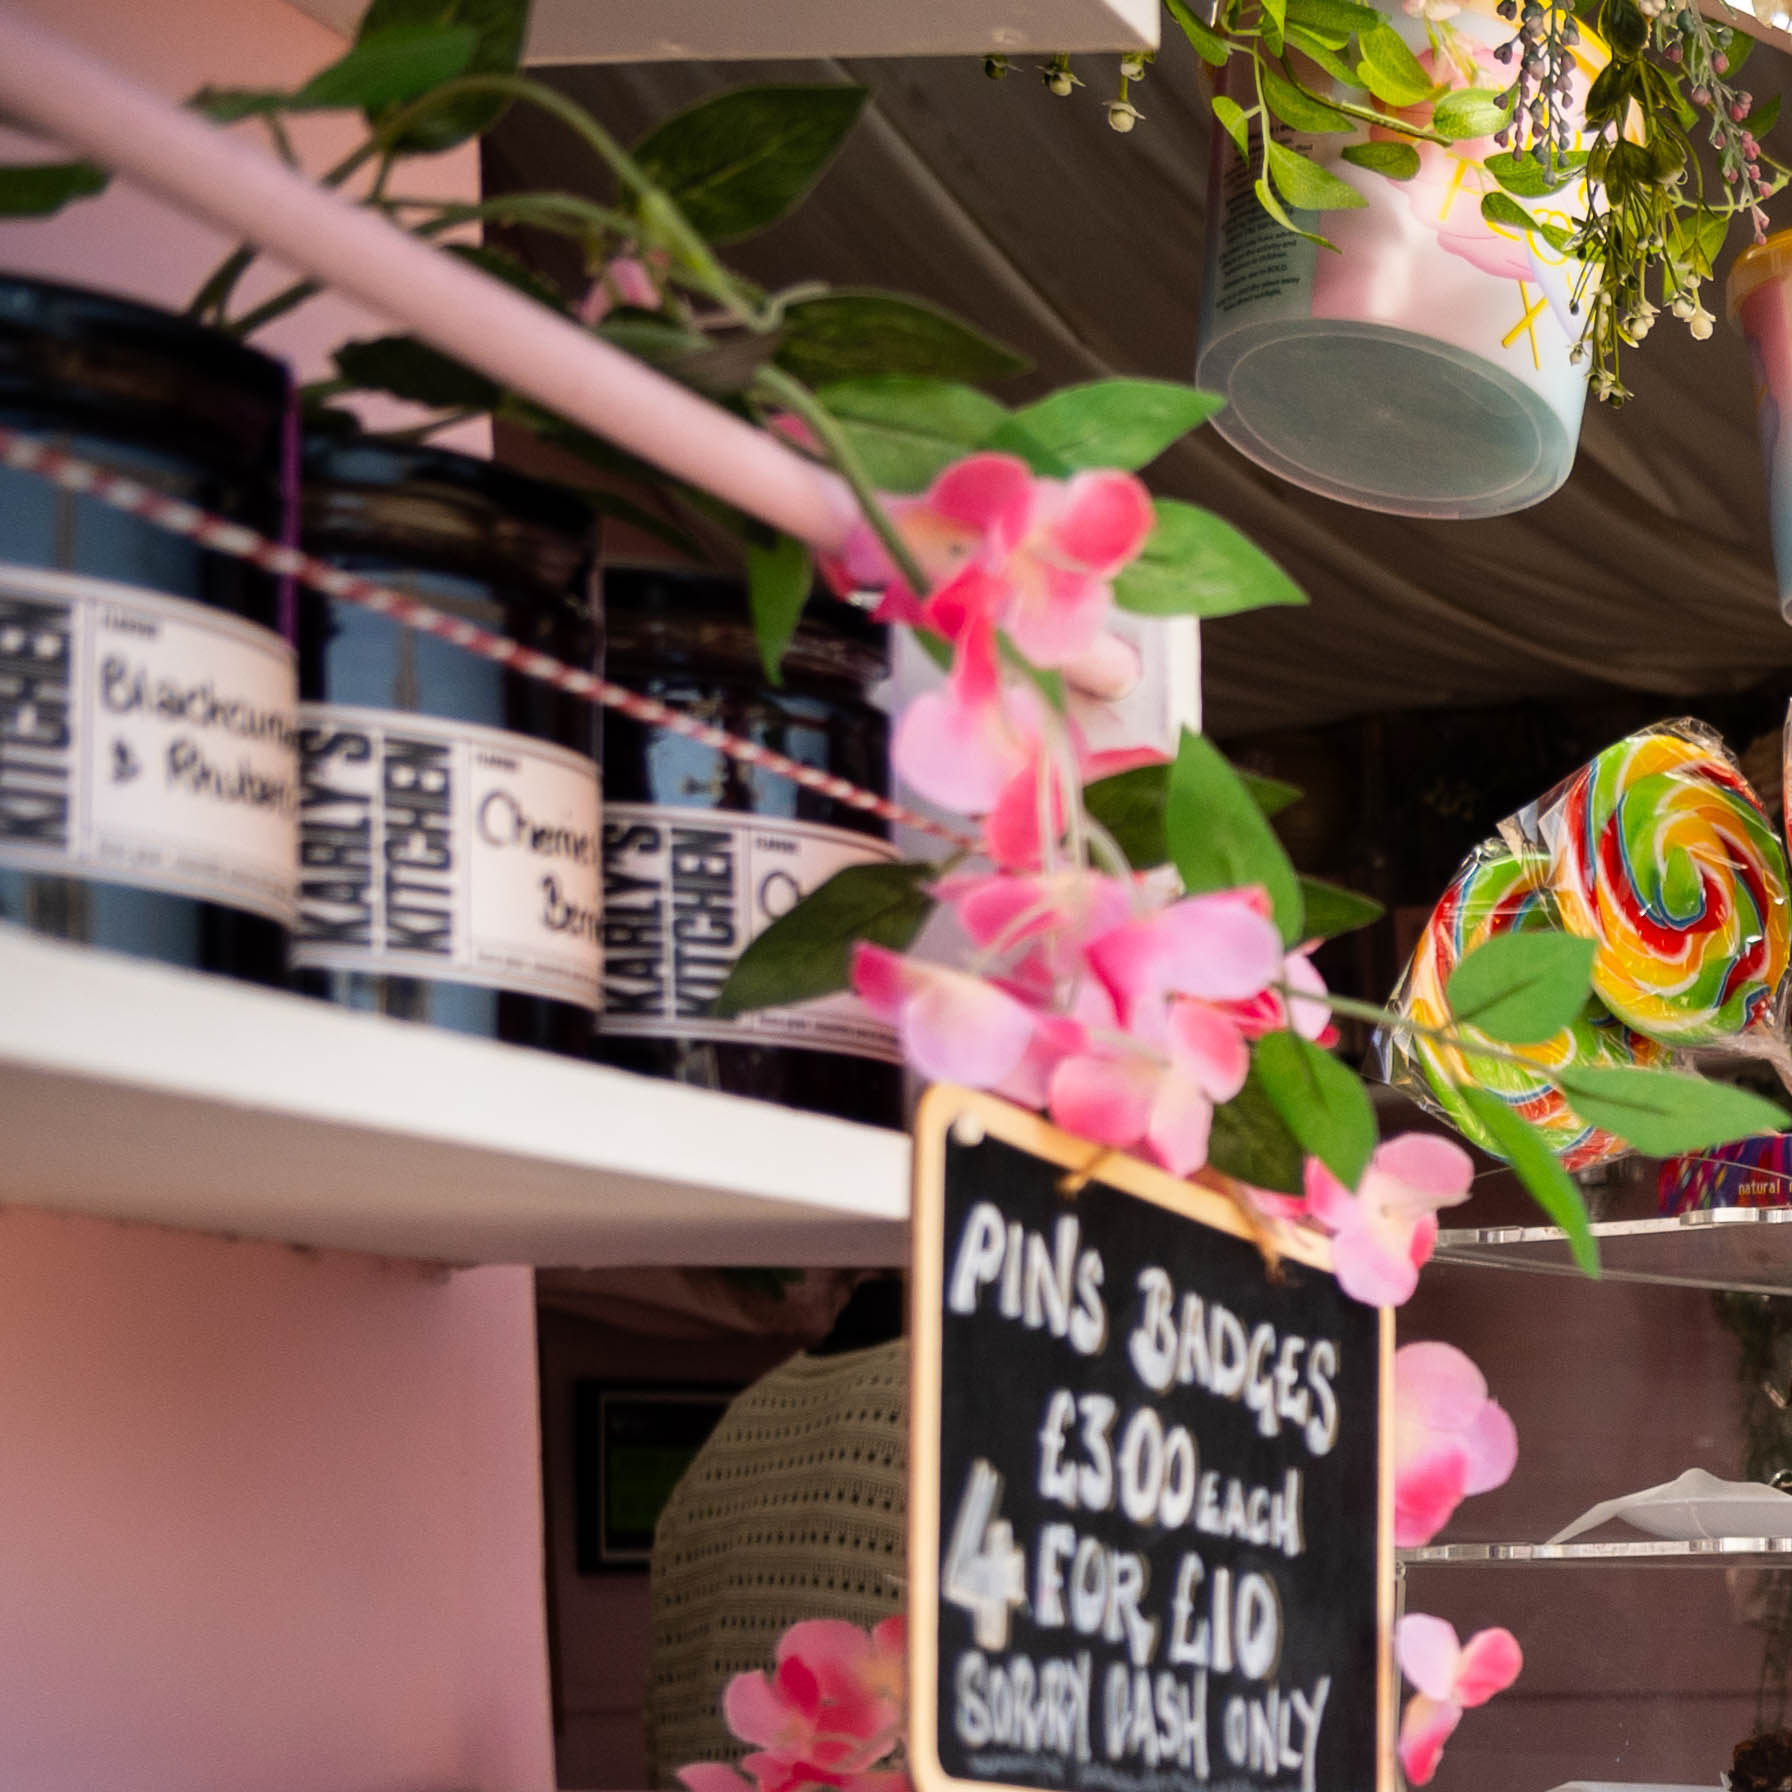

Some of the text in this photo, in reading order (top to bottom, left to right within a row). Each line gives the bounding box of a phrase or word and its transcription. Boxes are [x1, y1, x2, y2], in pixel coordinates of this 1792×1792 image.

[385, 735, 453, 954] KITCHEN
[1738, 1179, 1781, 1196] natural
[949, 1204, 1106, 1356] PINS
[1129, 1267, 1340, 1456] BADGES
[945, 1460, 1282, 1680] 4 FOR £10
[1199, 1470, 1305, 1556] EACH
[957, 1651, 1091, 1761] SORRY
[1105, 1666, 1209, 1779] CASH
